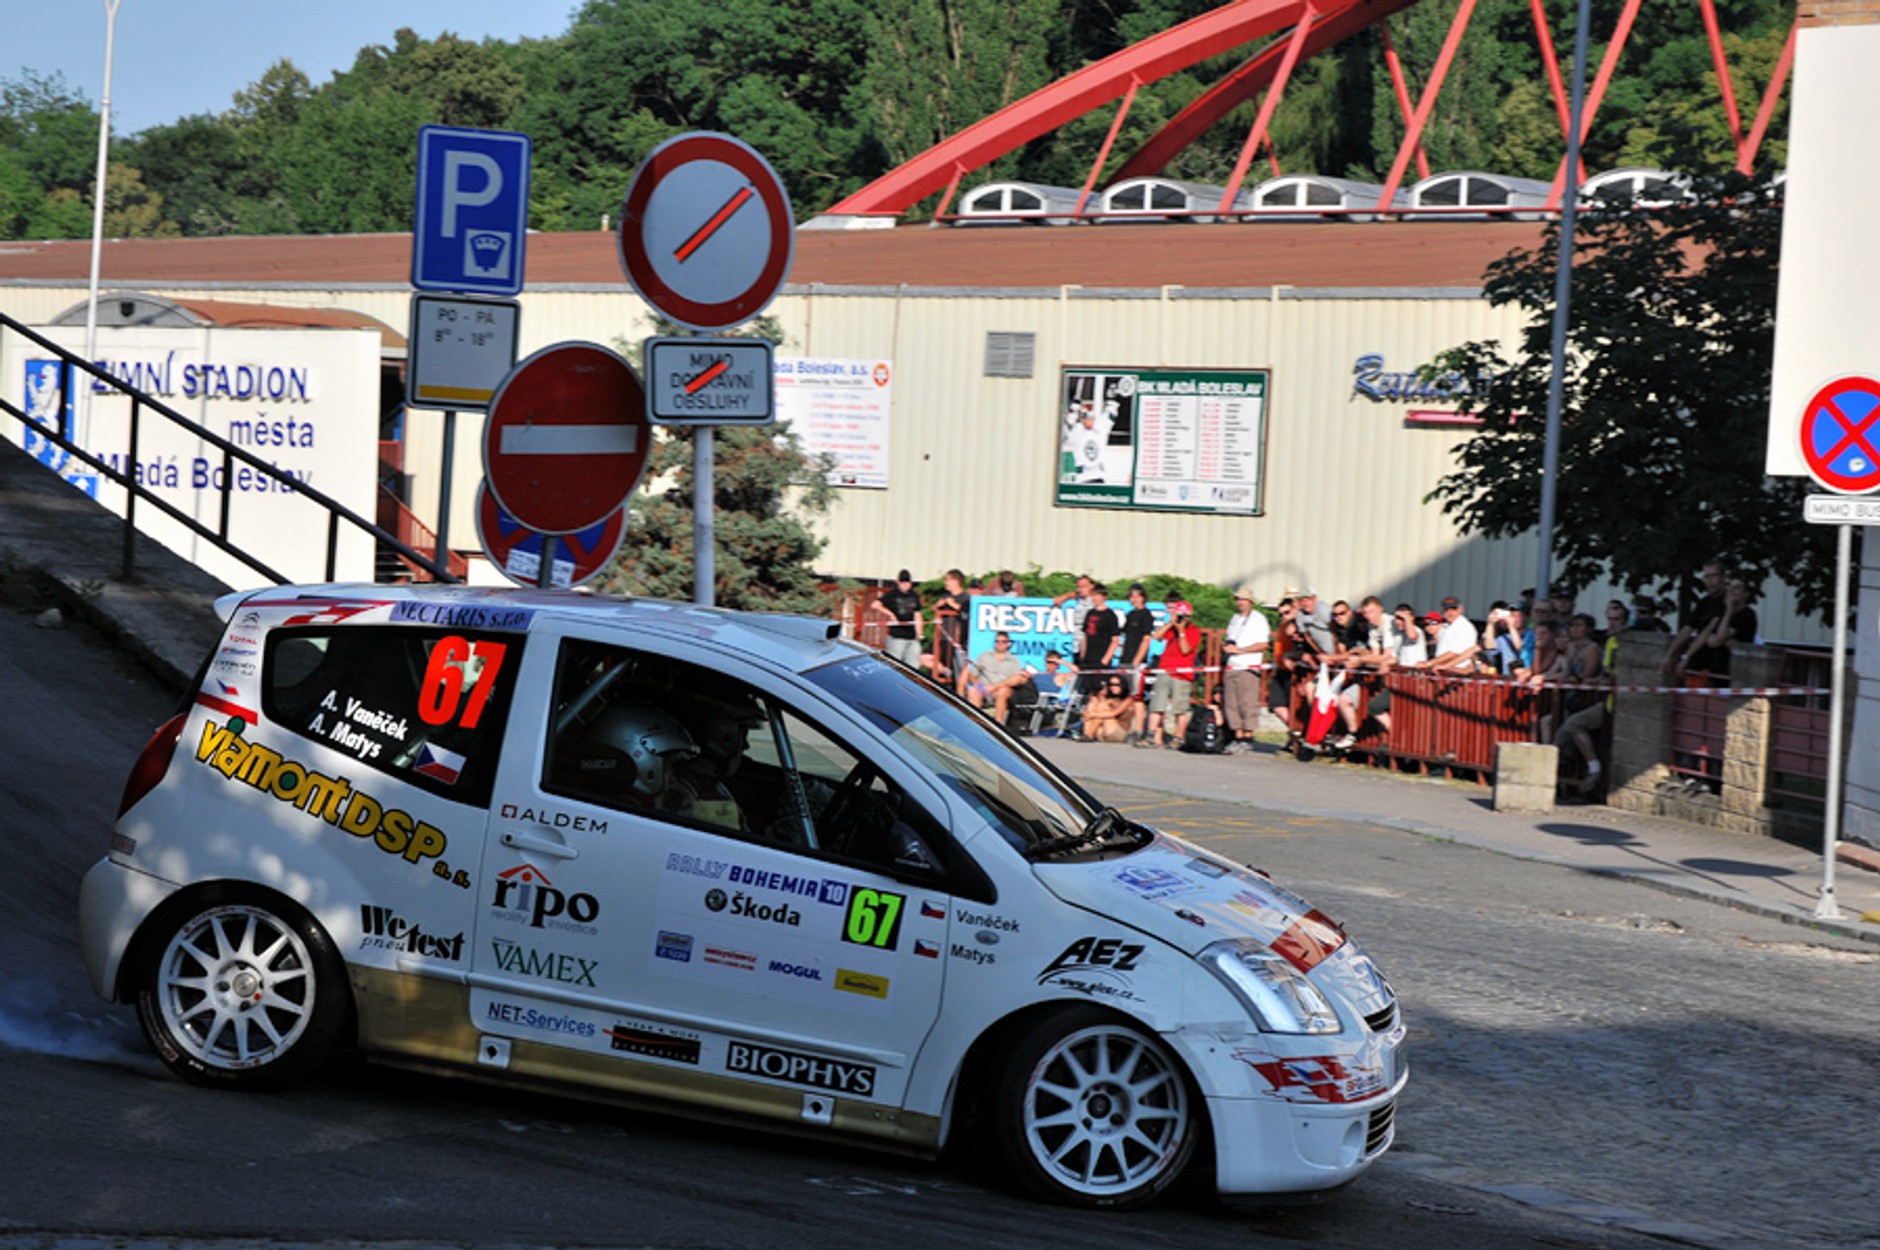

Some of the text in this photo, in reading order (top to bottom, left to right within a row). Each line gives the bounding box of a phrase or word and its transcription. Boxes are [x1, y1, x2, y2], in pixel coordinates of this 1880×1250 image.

[441, 150, 504, 238] P
[183, 364, 308, 399] STADION
[670, 369, 755, 390] DOAVNÍ
[672, 393, 751, 410] OBSLUHY
[229, 411, 315, 448] města
[192, 457, 313, 494] Boeslav
[395, 600, 487, 627] NECTARIS
[418, 635, 507, 728] 67
[320, 690, 409, 742] A. Vaněček
[309, 713, 383, 761] A. Matys
[520, 808, 609, 835] ALDEM
[665, 853, 727, 880] RALLY
[728, 865, 820, 899] BOHEMIA
[491, 870, 601, 930] ripo
[729, 892, 802, 927] Škoda
[847, 887, 902, 947] 67
[491, 942, 600, 988] VAMEX
[768, 960, 822, 982] MOGUL
[951, 944, 997, 965] Matys
[1035, 936, 1146, 980] AEZ
[487, 1000, 597, 1038] NET-Services
[730, 1043, 874, 1095] BIOPHYS
